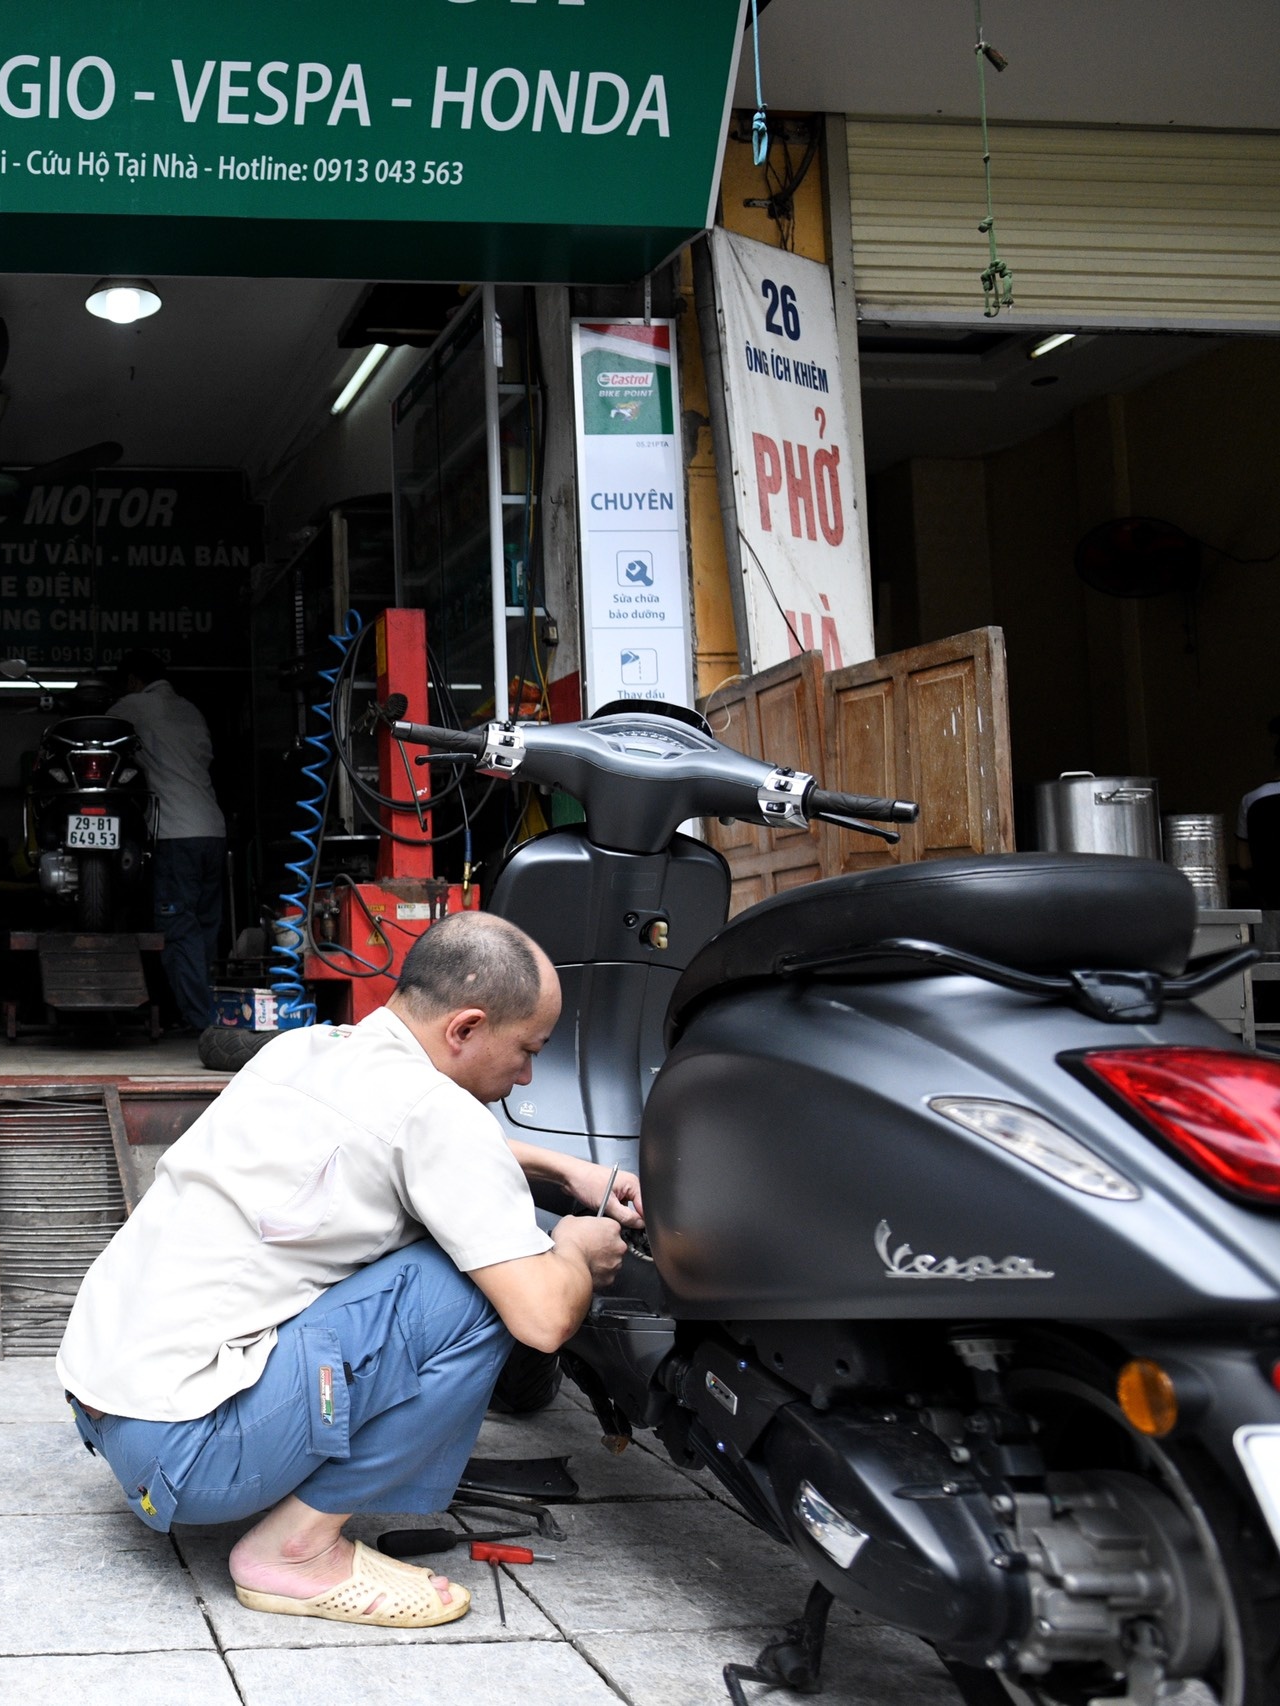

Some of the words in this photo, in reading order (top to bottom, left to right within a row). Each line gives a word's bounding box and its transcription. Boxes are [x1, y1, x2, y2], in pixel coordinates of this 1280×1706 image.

[172, 60, 371, 126] VESPA
[431, 66, 669, 137] HONDA
[27, 151, 70, 175] Cứu
[79, 152, 109, 182] Hộ
[115, 153, 146, 183] Tại
[153, 153, 197, 178] Nhà
[219, 156, 307, 181] Hotline:
[314, 159, 368, 182] 0913
[375, 160, 415, 183] 043
[422, 161, 463, 184] 563
[762, 279, 800, 341] 26
[611, 374, 649, 385] Castrol
[745, 340, 769, 376] ÔNG
[770, 347, 791, 383] ÍCH
[794, 361, 829, 393] KHIÊM
[752, 407, 843, 547] PHỞ
[23, 484, 178, 527] MOTOR
[590, 488, 674, 511] CHUYÊN
[127, 545, 186, 567] MUA
[195, 538, 249, 567] BÁN
[26, 571, 90, 604] ĐIỆN
[613, 593, 632, 603] Sửa
[635, 593, 660, 603] chữa
[148, 606, 213, 640] HIỆU
[609, 609, 629, 619] bảo
[631, 609, 665, 621] dưỡng
[617, 690, 642, 699] Thay
[70, 831, 116, 846] 649.53
[874, 1219, 1055, 1282] Vespa
